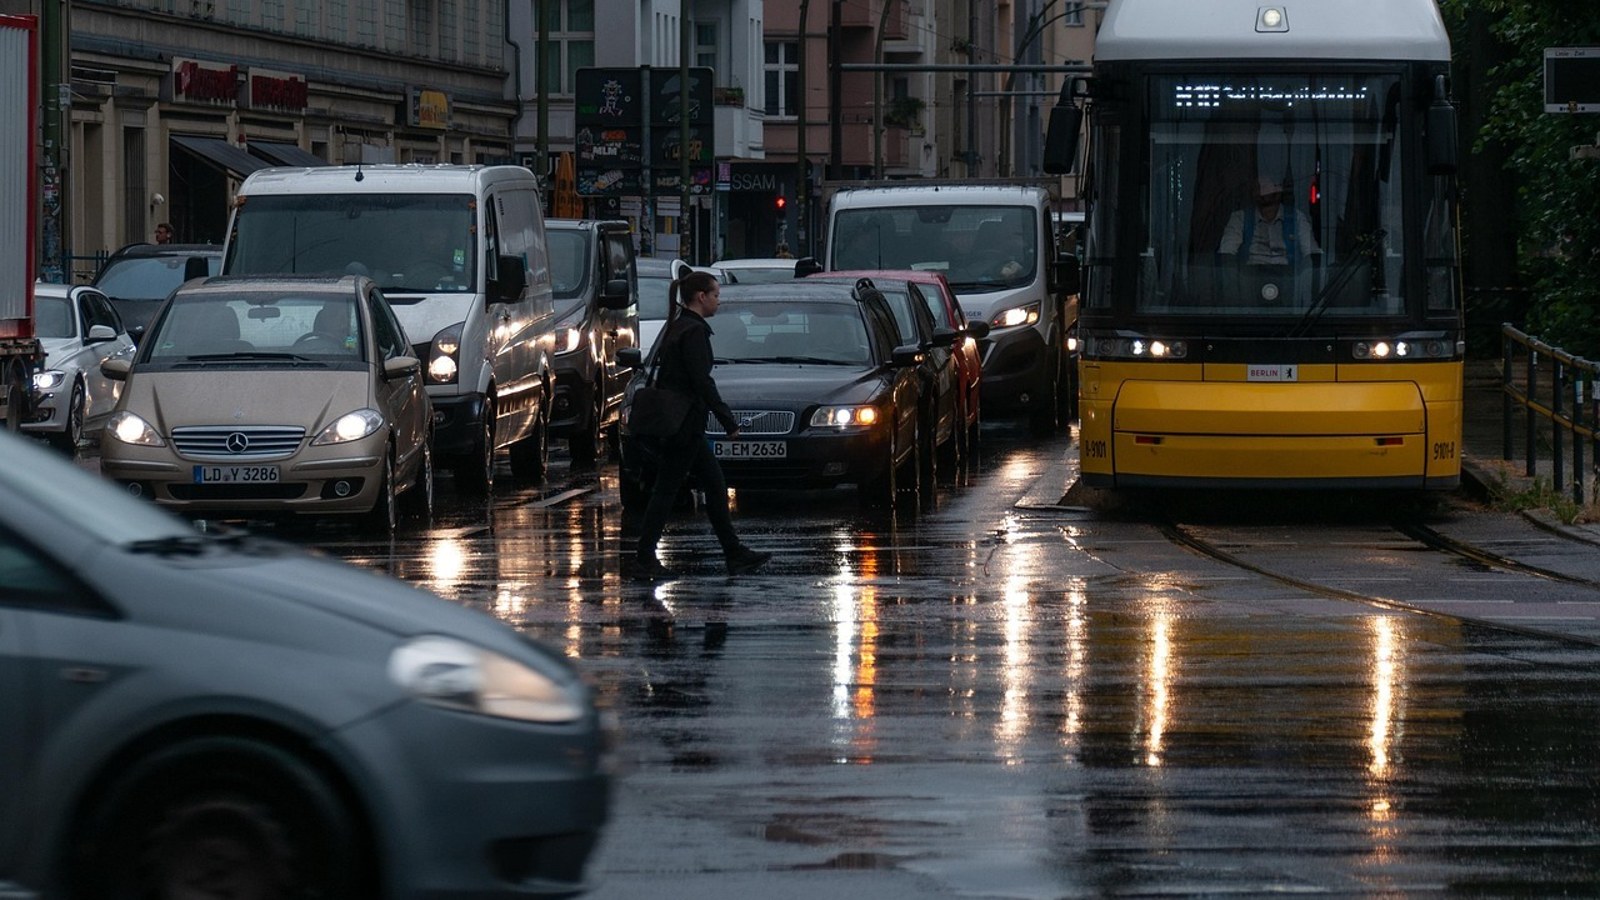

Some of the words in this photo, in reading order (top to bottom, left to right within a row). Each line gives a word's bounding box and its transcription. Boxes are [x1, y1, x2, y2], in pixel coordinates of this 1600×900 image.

[1250, 369, 1279, 377] BERLIN
[714, 443, 723, 456] B
[732, 443, 750, 456] EM
[752, 443, 785, 456] 2636
[203, 468, 221, 481] LD
[231, 468, 239, 481] Y
[243, 467, 277, 481] 3286
